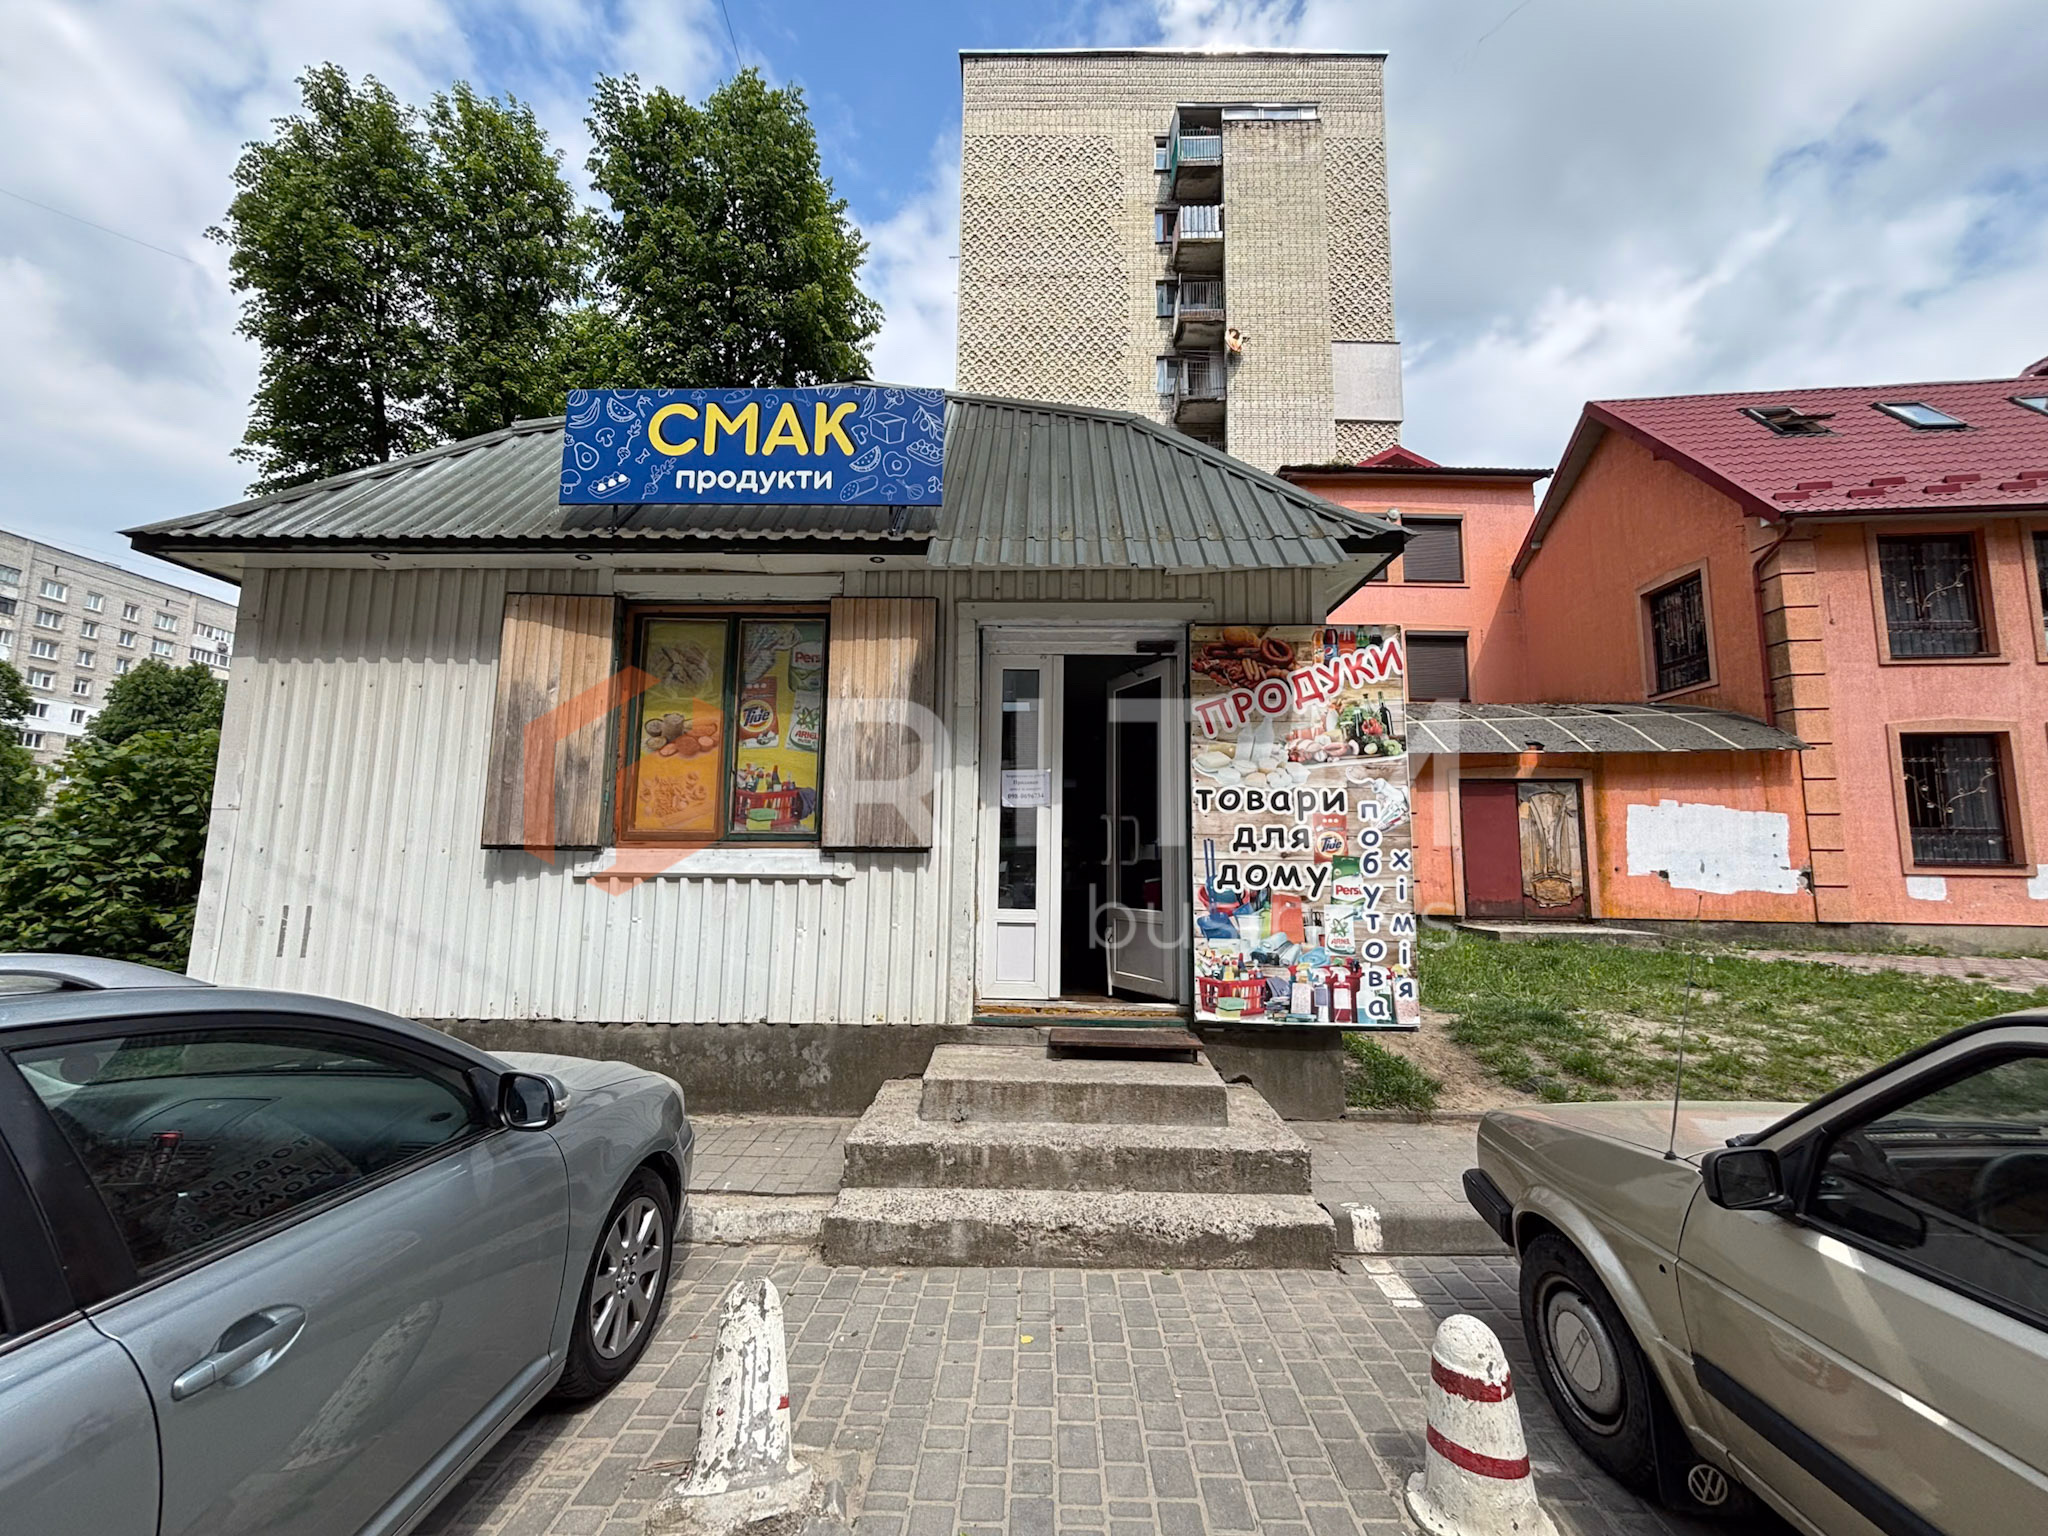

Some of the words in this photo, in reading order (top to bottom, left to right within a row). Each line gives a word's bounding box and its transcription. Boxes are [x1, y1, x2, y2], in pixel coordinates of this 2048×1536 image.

[647, 402, 859, 456] СМАК
[675, 470, 832, 494] продукти
[1195, 640, 1403, 734] ПРОДУКИ
[743, 706, 771, 726] Tide
[1196, 790, 1346, 821] товари
[1233, 827, 1310, 852] для
[1321, 836, 1342, 852] Tide
[1217, 864, 1328, 897] дому
[1360, 803, 1387, 1017] побутова
[1392, 851, 1414, 998] хімія
